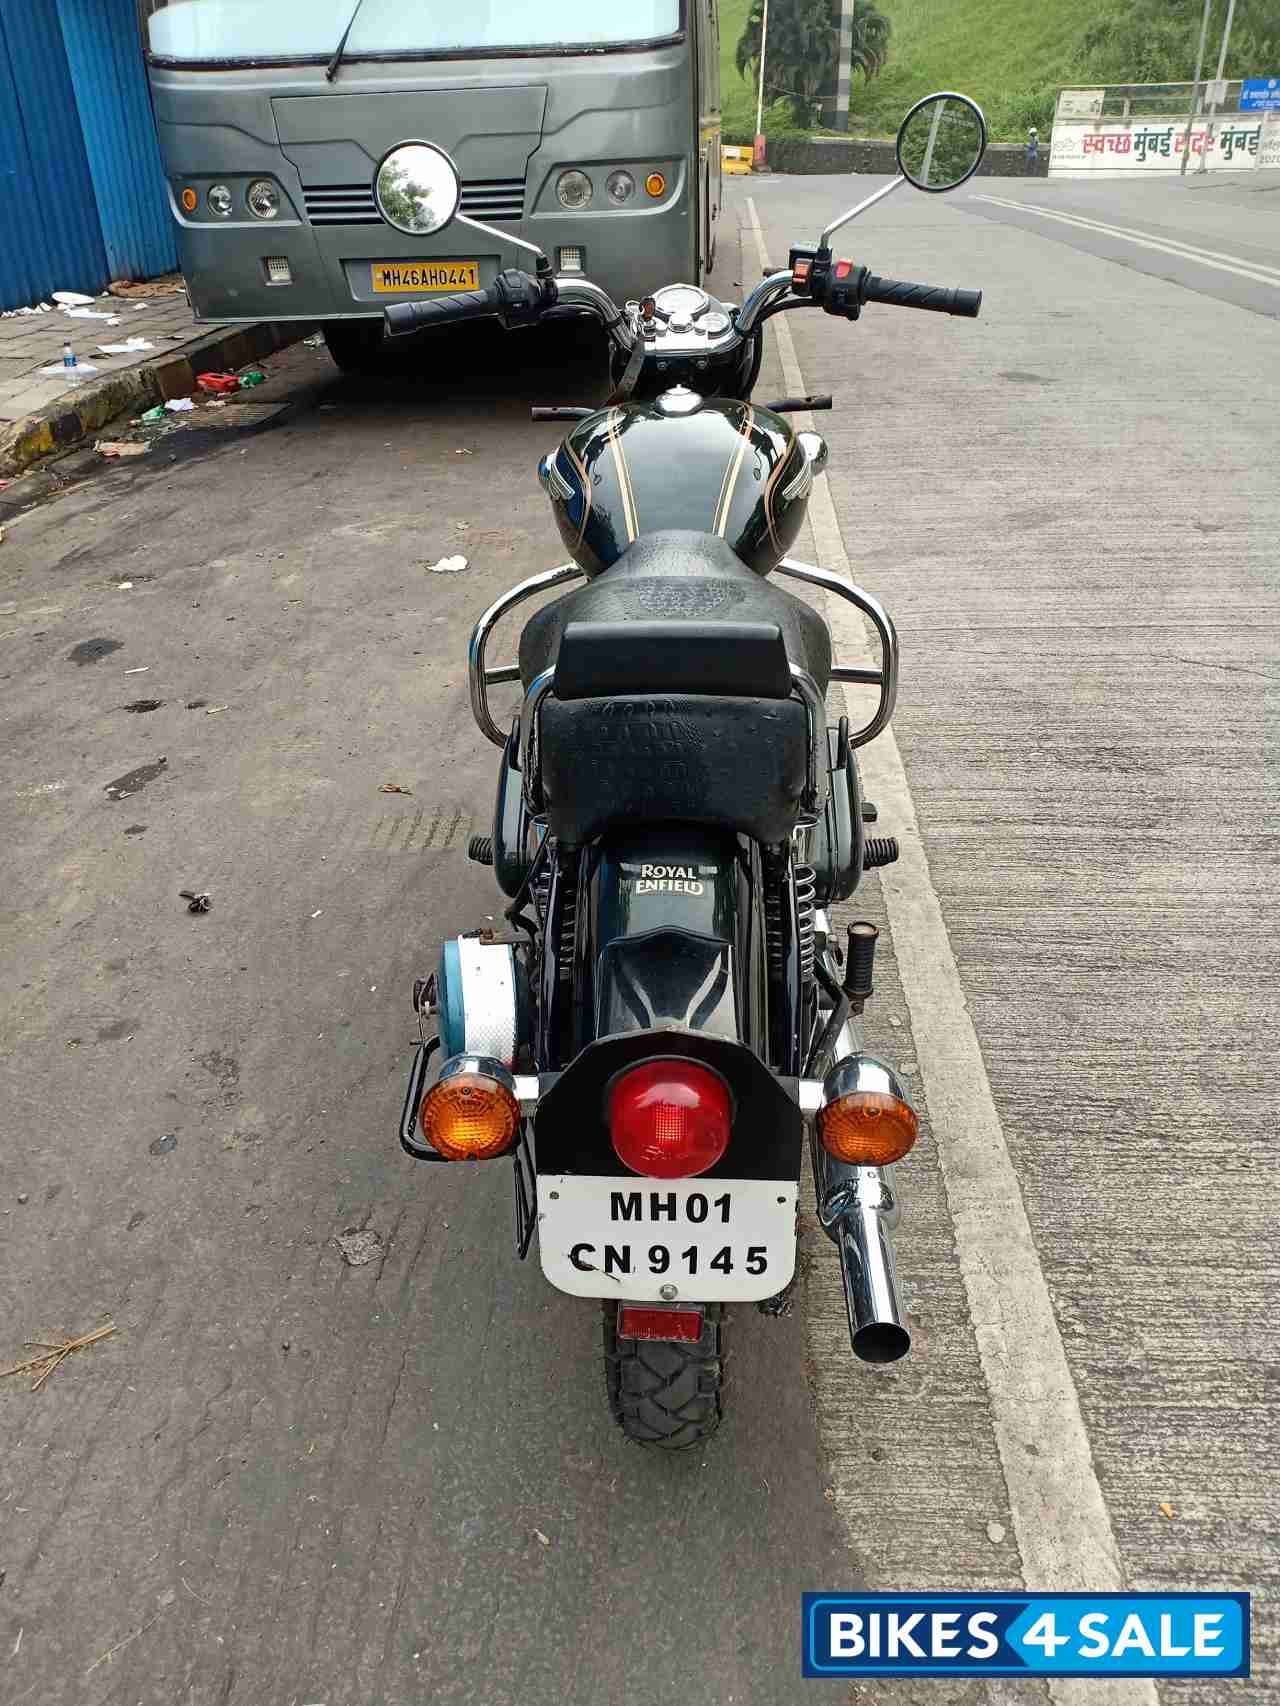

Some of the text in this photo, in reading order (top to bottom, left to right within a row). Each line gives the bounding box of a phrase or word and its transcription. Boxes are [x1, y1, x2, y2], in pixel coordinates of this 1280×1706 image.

[1083, 133, 1132, 154] स्वच्छ
[1134, 127, 1174, 162] मुंबई
[382, 268, 475, 287] MH46AH0441
[641, 864, 697, 880] ROYAL
[636, 879, 704, 896] ENFIELD
[610, 1192, 732, 1224] MH01
